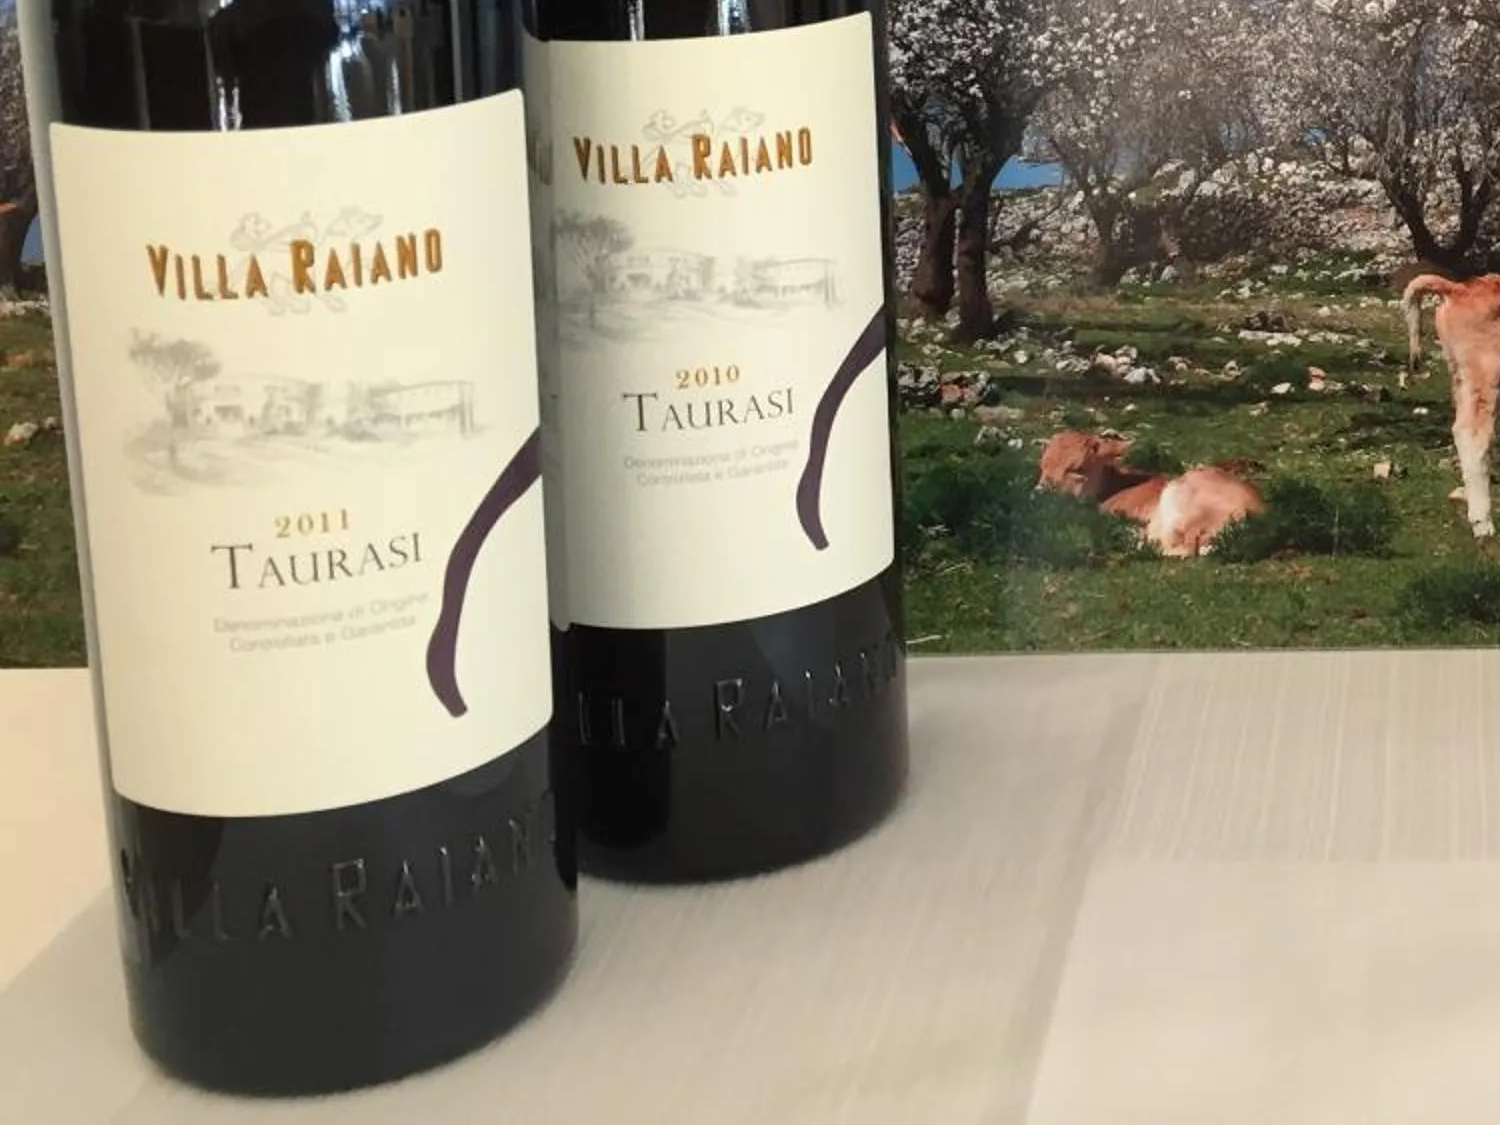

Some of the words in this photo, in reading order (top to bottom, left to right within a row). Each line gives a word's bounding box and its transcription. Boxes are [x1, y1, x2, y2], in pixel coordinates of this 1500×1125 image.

[573, 136, 673, 185] VILLA
[690, 126, 814, 181] RAIANO
[145, 243, 268, 300] VILLA
[289, 228, 443, 295] RAIANO
[675, 364, 741, 390] 2010
[622, 386, 795, 433] TAURASI
[273, 508, 351, 539] 2011
[209, 531, 423, 590] TAURASI
